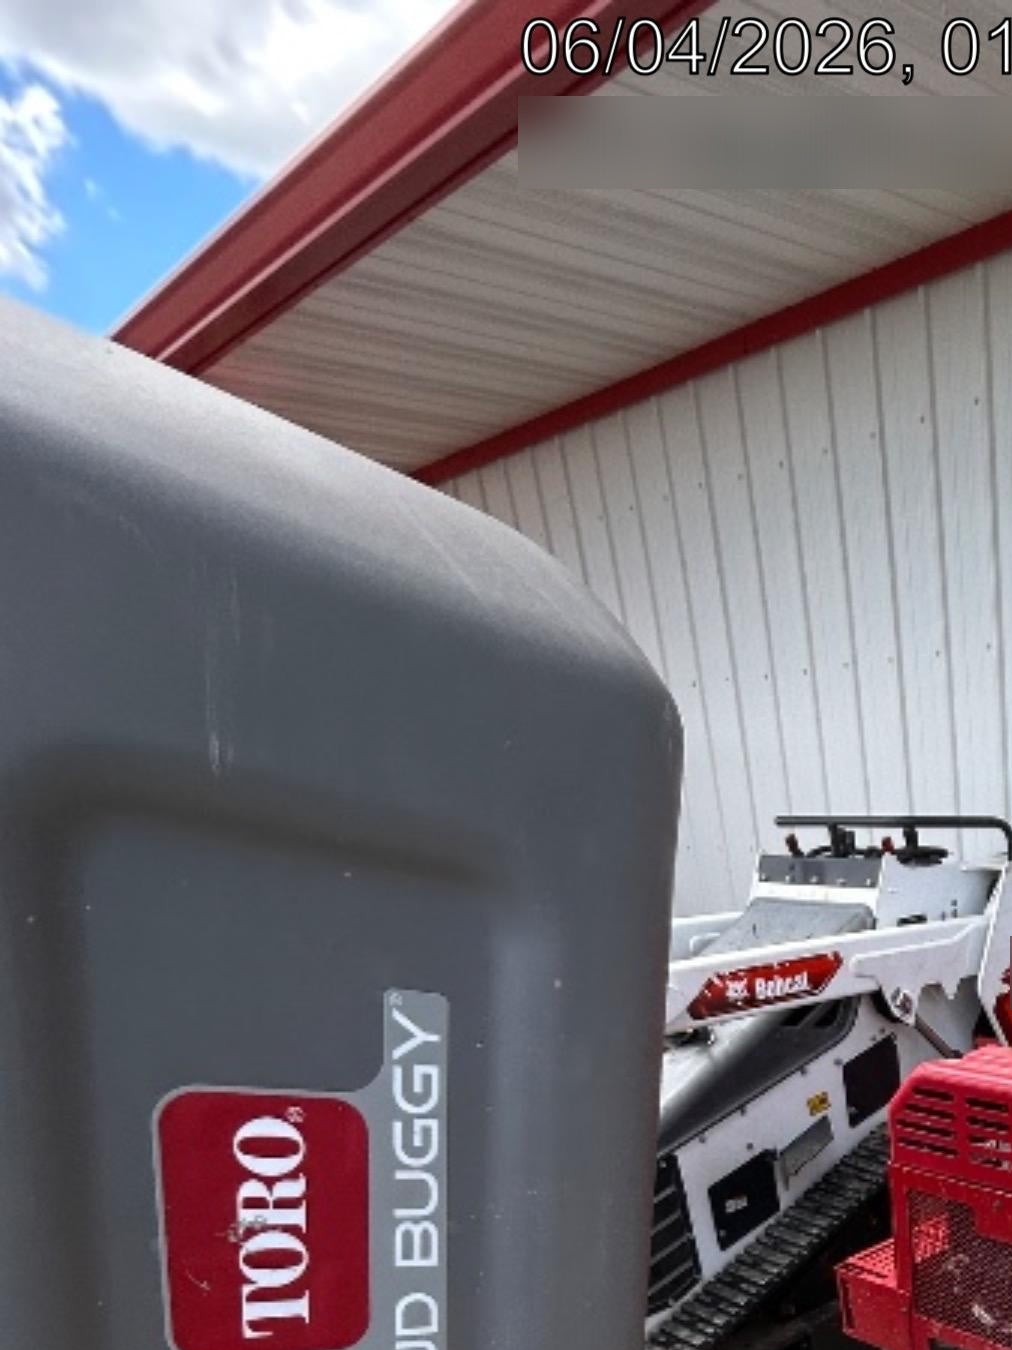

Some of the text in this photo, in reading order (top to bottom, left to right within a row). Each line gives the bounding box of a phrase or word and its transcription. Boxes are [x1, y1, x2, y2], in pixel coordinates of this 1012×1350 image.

[754, 971, 811, 1000] Bobcat
[231, 1115, 311, 1340] TORO
[390, 1007, 441, 1268] BUGGY
